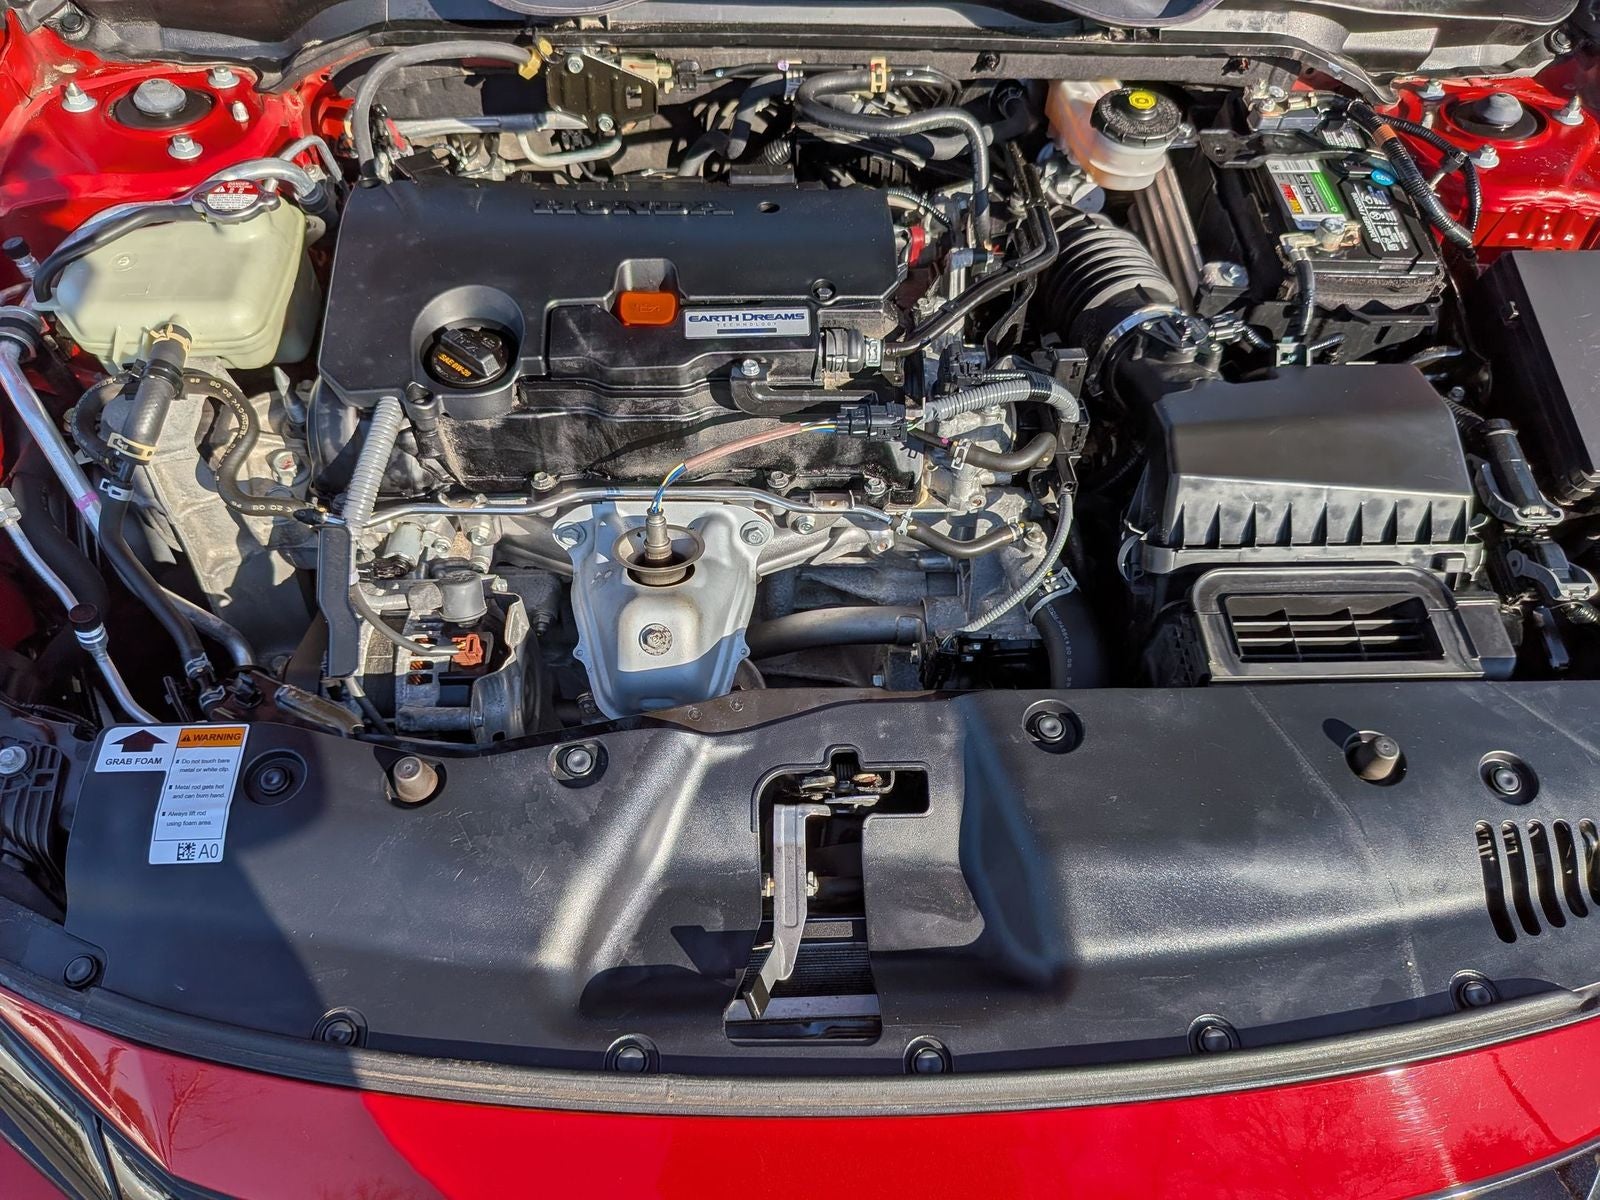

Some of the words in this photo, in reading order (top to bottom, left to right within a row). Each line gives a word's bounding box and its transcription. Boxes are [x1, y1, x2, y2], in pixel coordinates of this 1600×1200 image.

[532, 200, 734, 216] HONDA
[688, 314, 739, 322] EARTH
[742, 313, 805, 322] DREAMS
[438, 353, 455, 366] SAE
[193, 733, 242, 742] WARNING
[105, 758, 132, 766] GRAB
[134, 757, 162, 765] FOAM
[198, 843, 219, 859] A0
